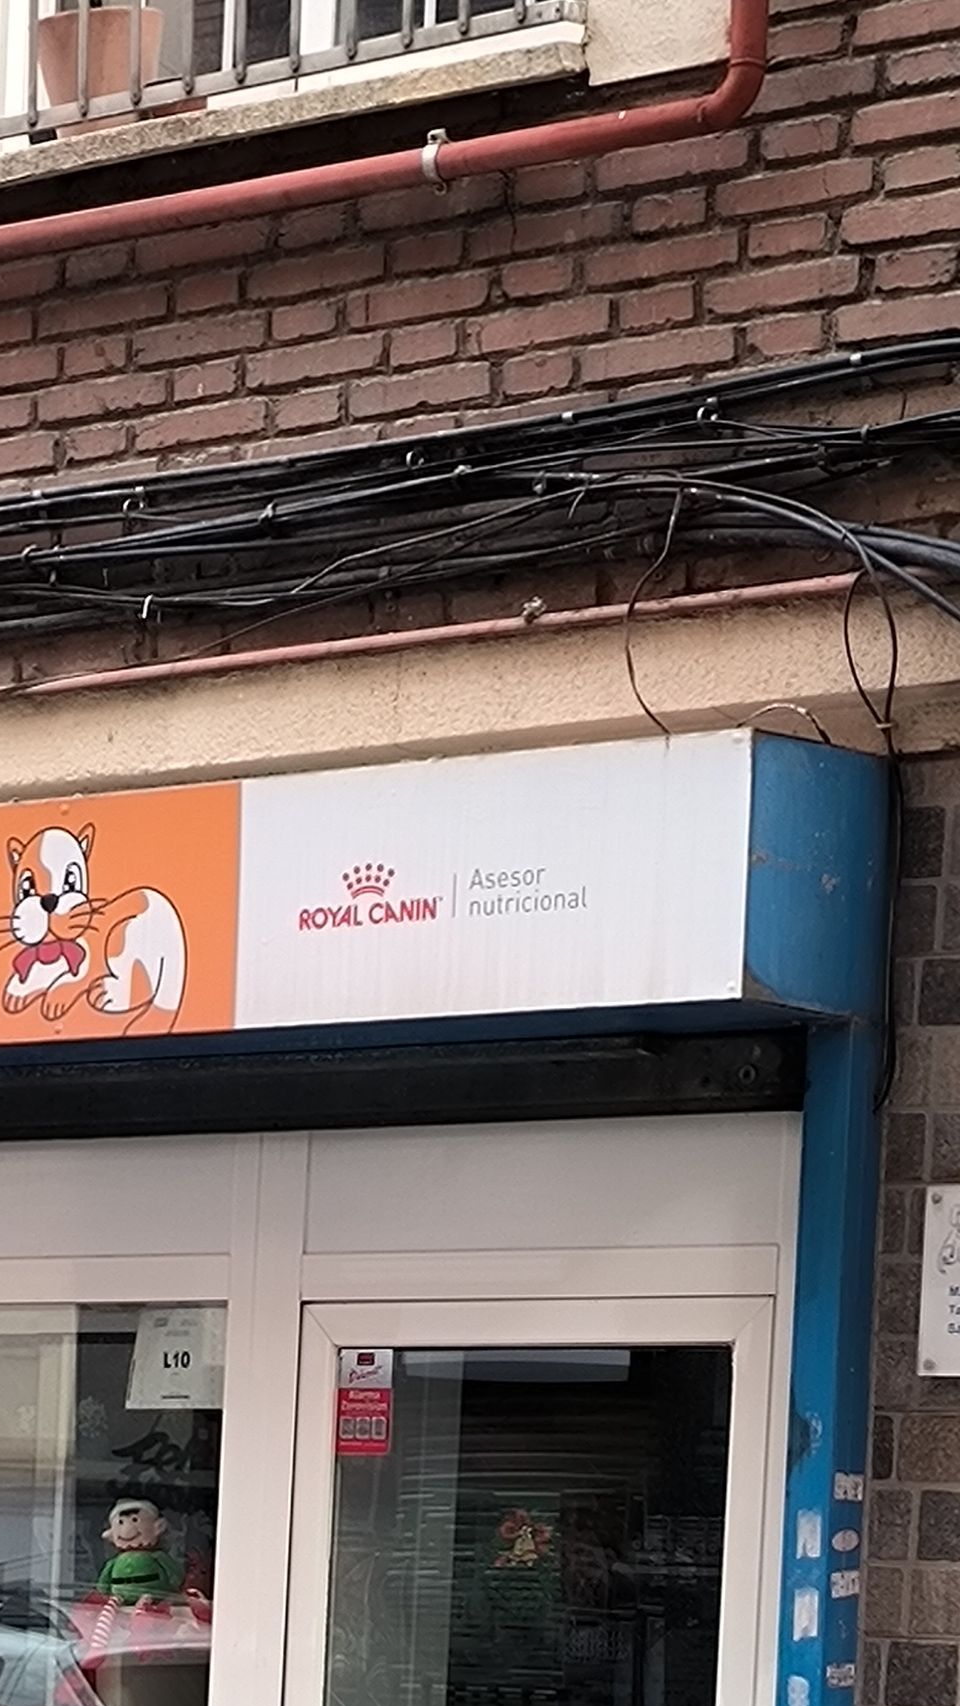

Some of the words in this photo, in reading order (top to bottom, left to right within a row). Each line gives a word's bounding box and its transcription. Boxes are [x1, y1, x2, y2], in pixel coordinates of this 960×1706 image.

[468, 866, 546, 889] Asesor
[298, 904, 364, 931] ROYAL
[368, 897, 438, 924] CANIN
[468, 886, 588, 918] nutricional
[163, 1350, 191, 1369] L10
